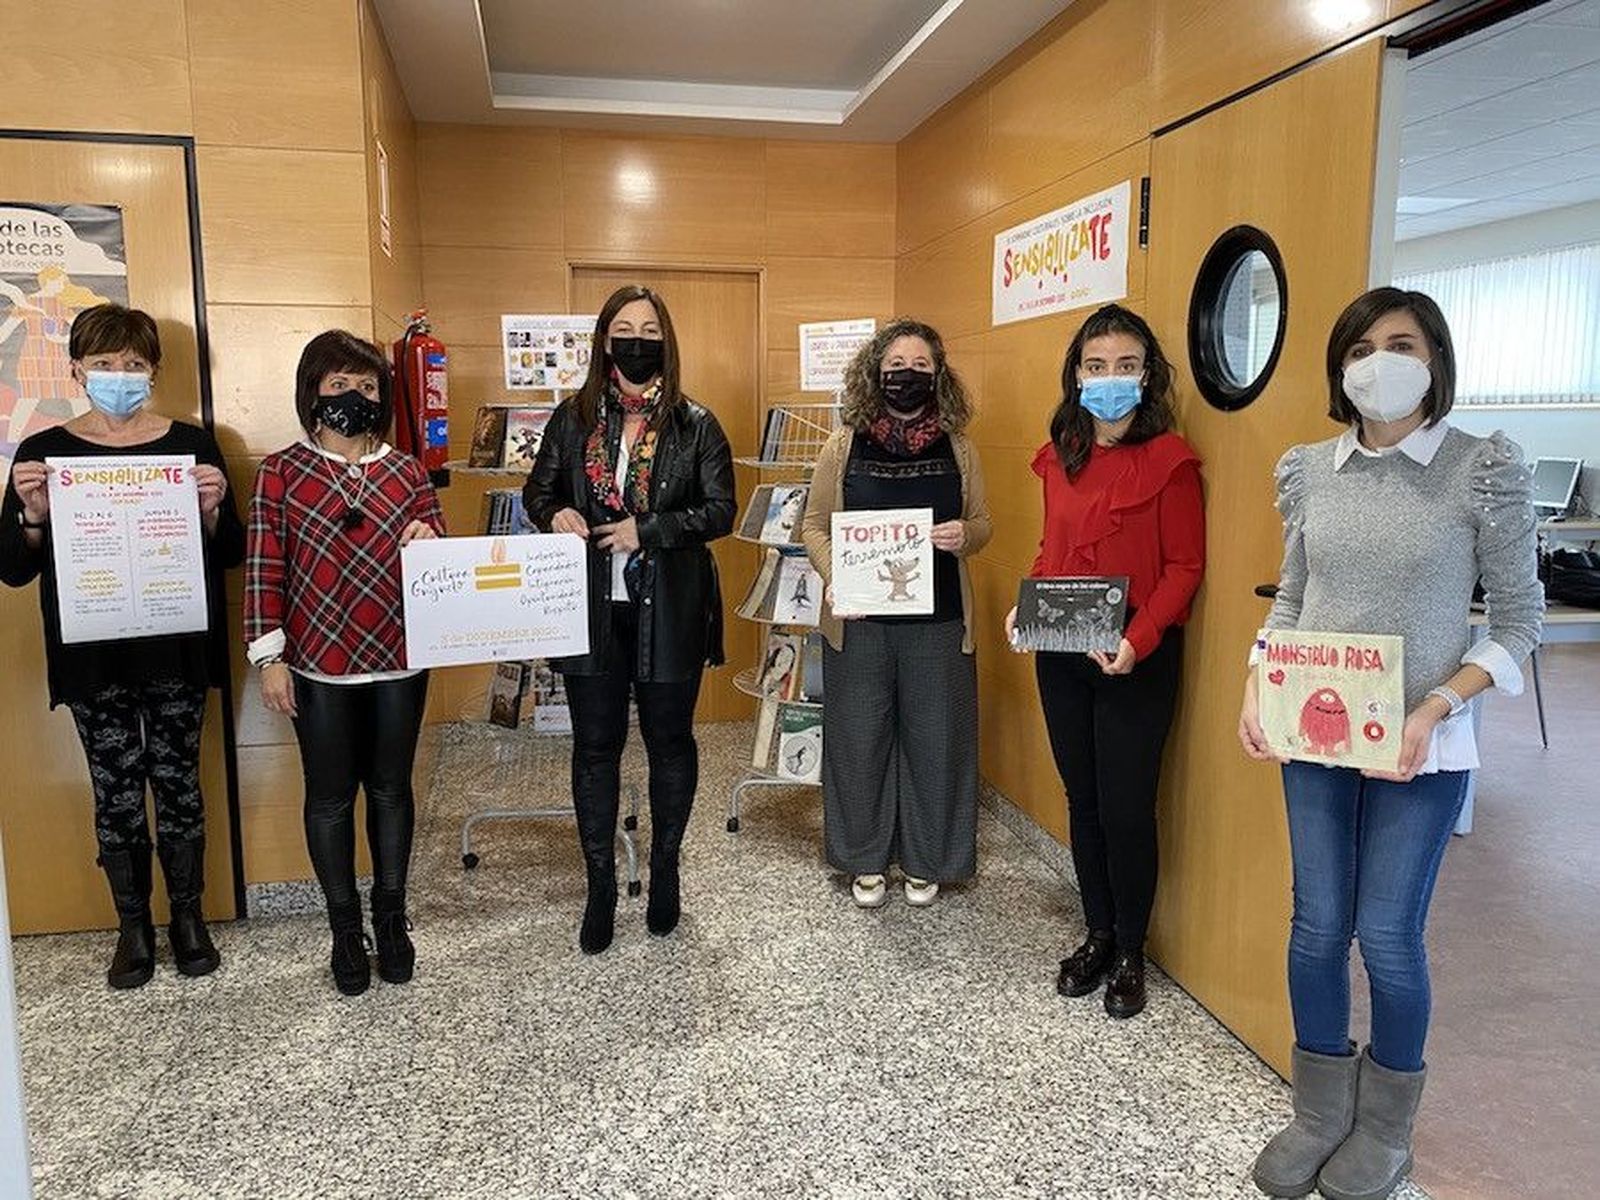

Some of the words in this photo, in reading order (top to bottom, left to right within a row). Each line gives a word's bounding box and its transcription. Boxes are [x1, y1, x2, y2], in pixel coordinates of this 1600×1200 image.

[0, 220, 26, 237] de
[33, 221, 63, 237] las
[841, 524, 918, 542] TOPITO
[1266, 643, 1339, 667] MONSTRUO
[1345, 646, 1384, 671] ROSA
